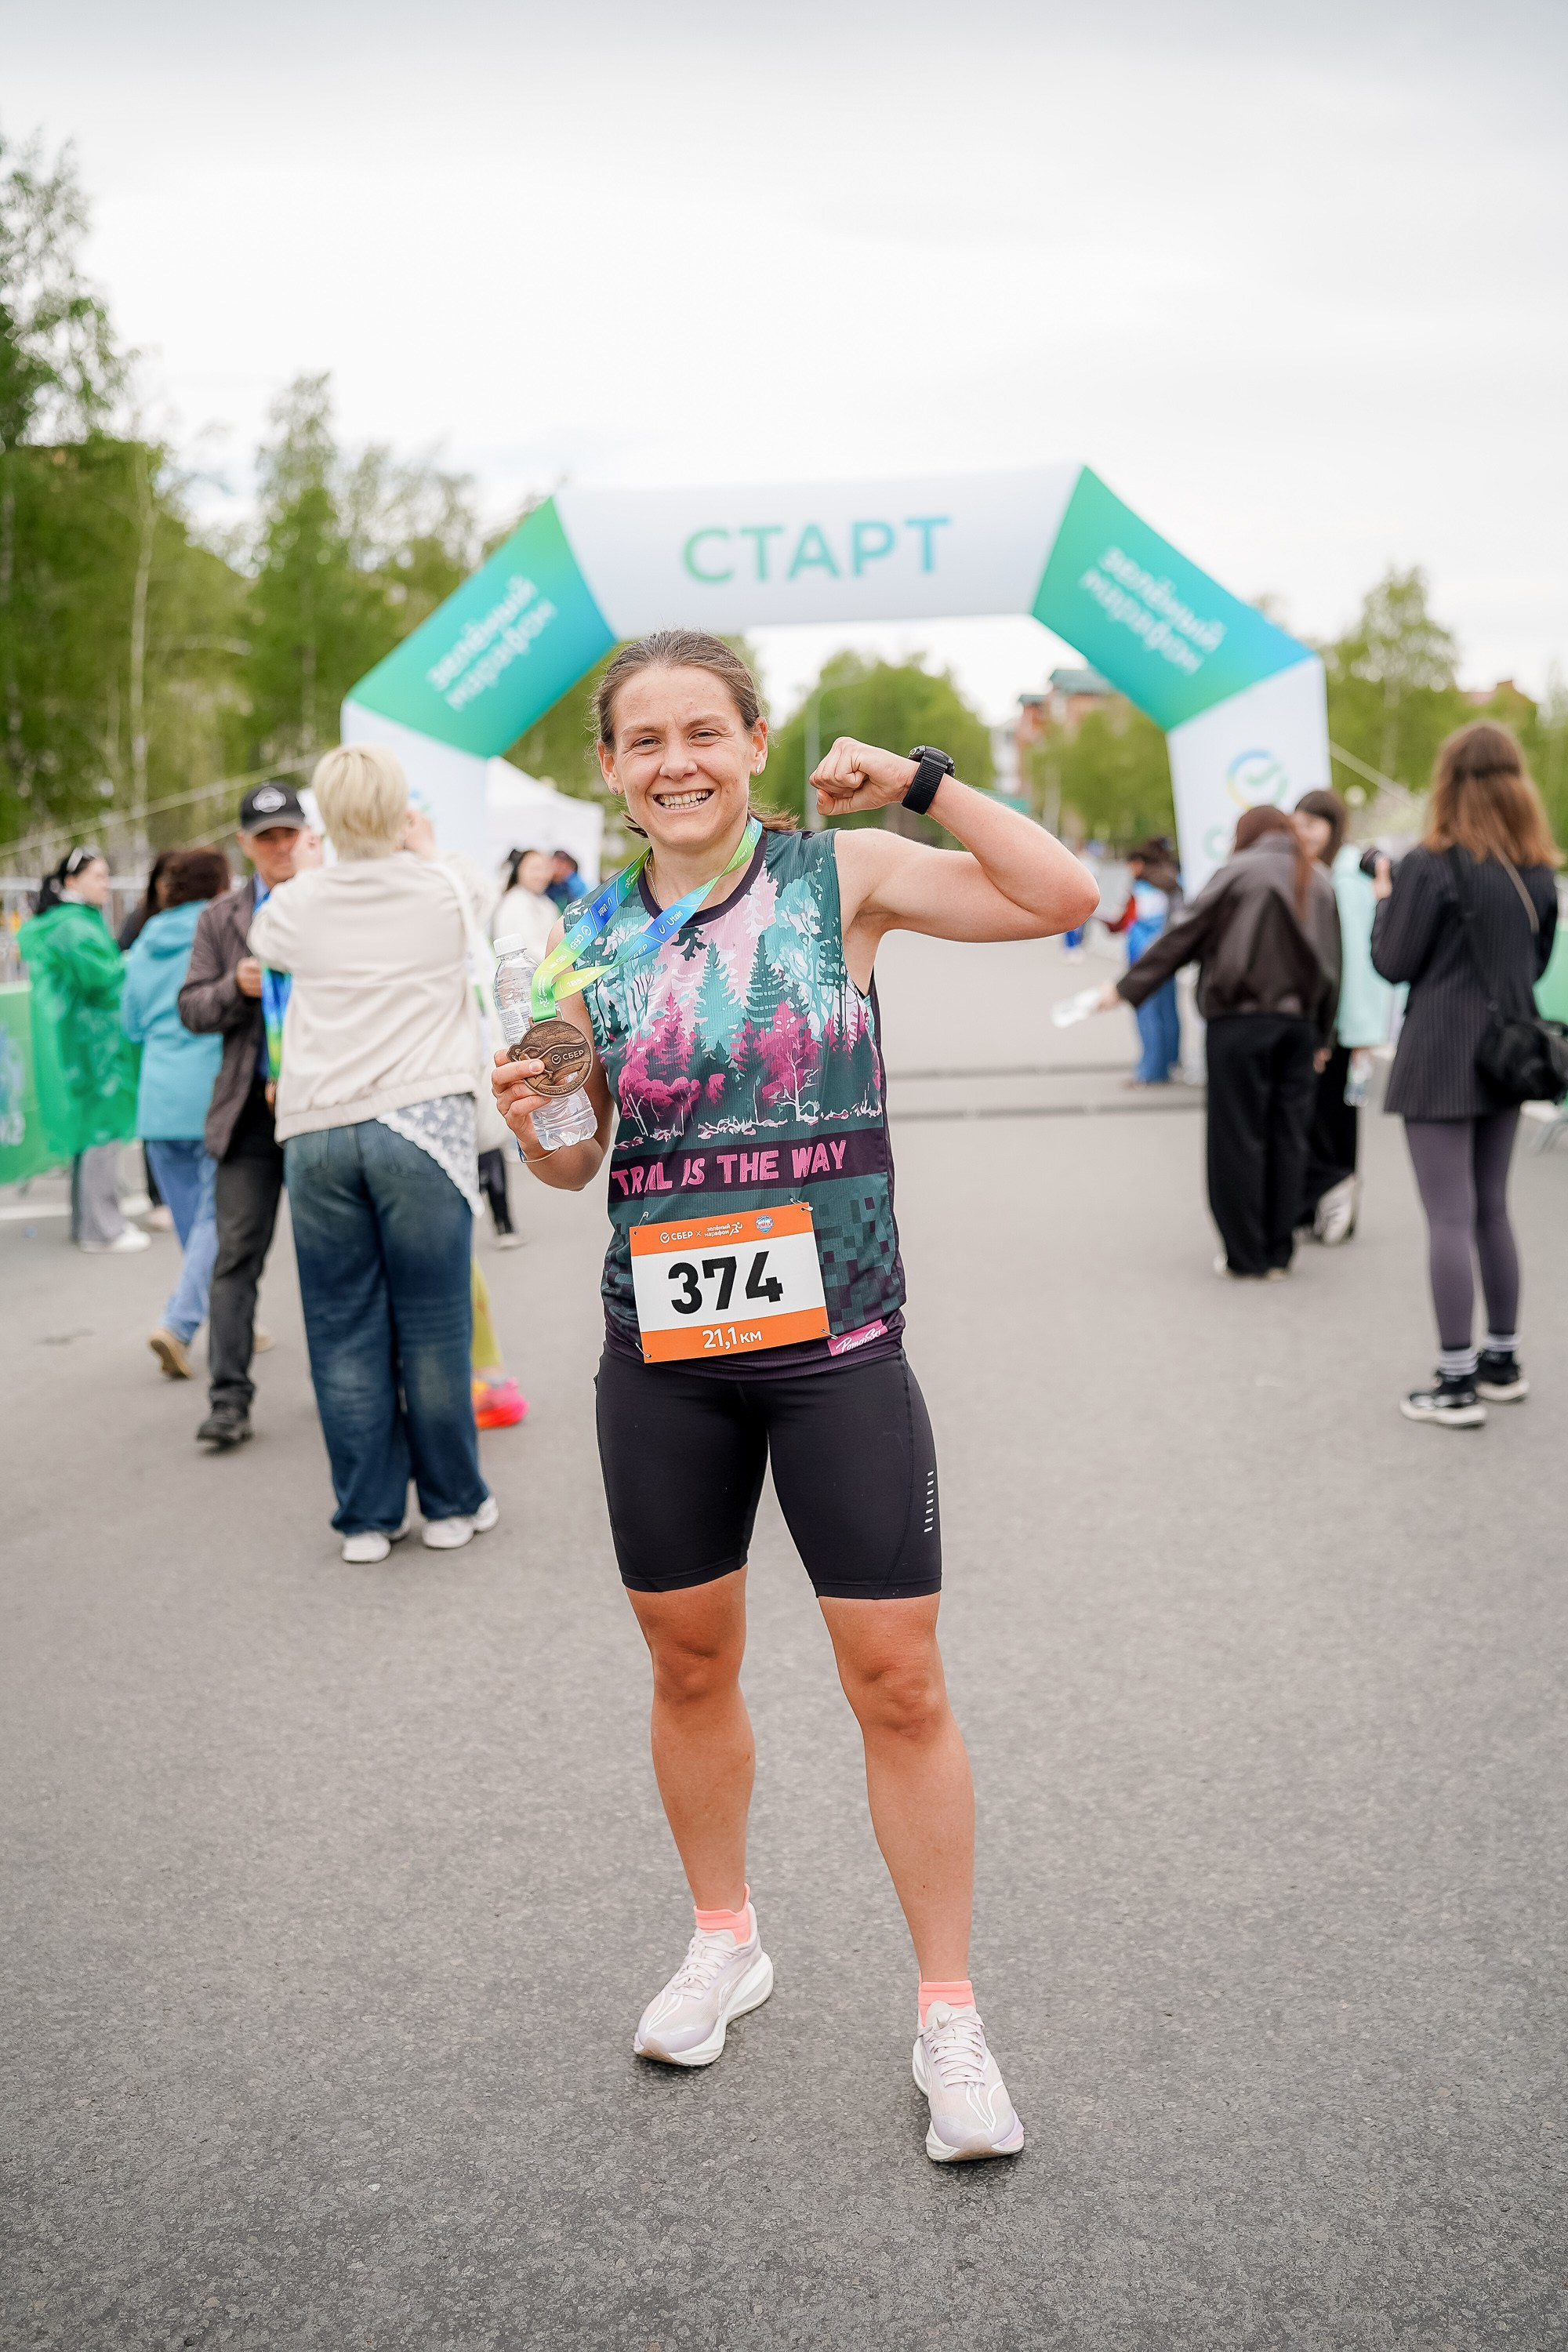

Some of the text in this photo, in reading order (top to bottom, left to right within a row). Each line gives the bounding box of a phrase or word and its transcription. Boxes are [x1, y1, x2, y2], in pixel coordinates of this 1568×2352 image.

[682, 516, 949, 583] СТАРТ
[666, 909, 684, 926] Utair
[569, 934, 584, 950] СБЕР
[562, 1050, 584, 1061] СБЕР
[681, 1157, 706, 1186] IS
[717, 1150, 779, 1184] THE
[791, 1140, 847, 1178] WAY
[671, 1231, 693, 1240] СБЕР
[668, 1250, 784, 1315] 374
[702, 1327, 737, 1350] 21,1
